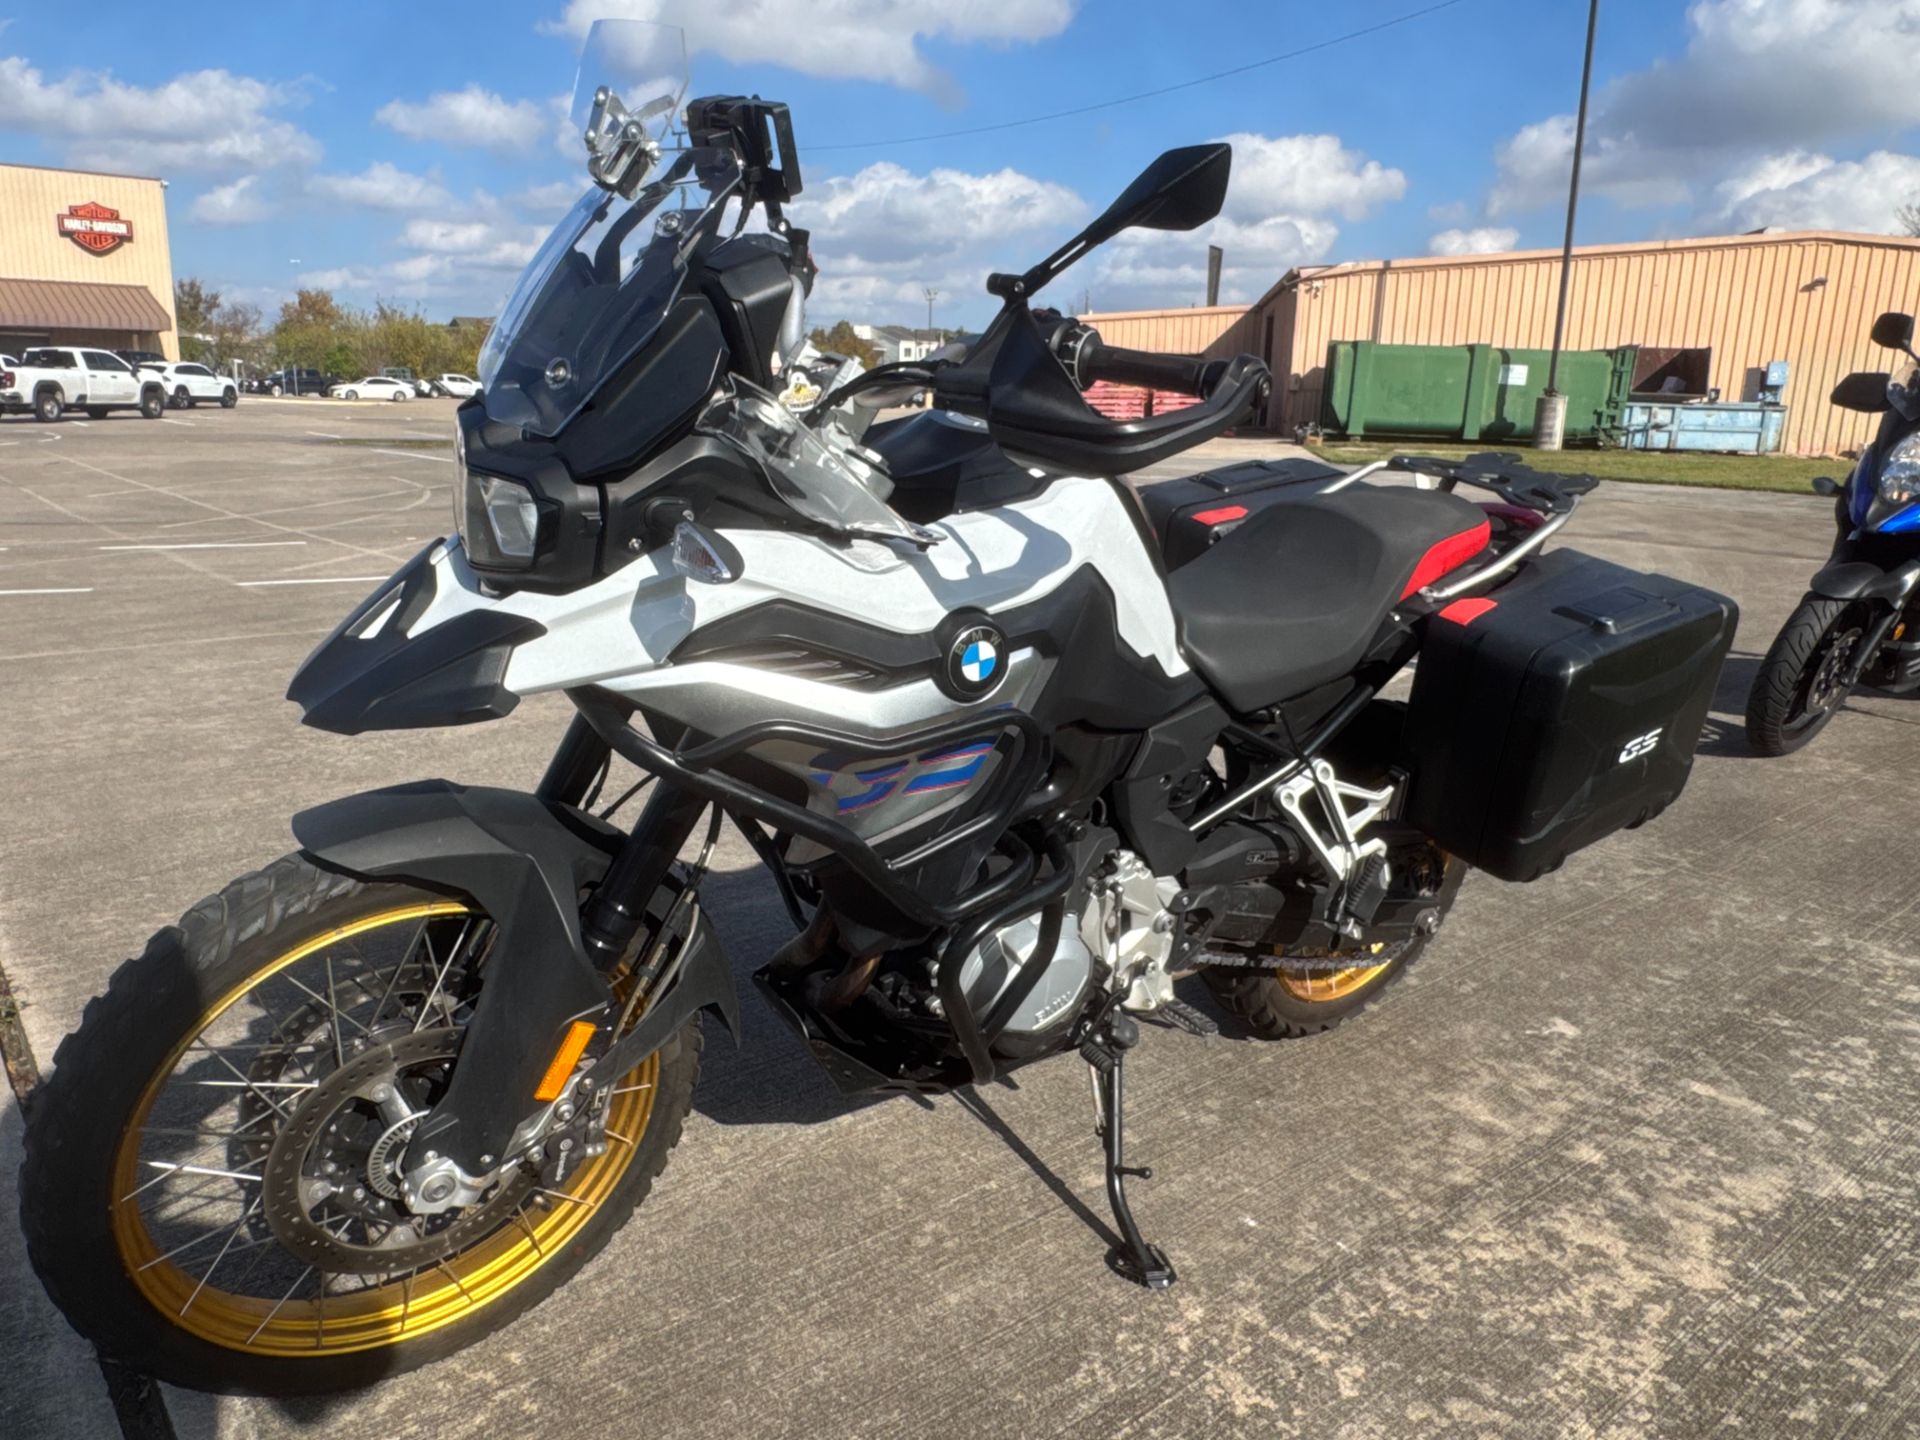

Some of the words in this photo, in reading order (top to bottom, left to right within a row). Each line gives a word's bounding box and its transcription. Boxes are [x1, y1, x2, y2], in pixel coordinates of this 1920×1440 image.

[63, 218, 128, 234] HARLEY-DAVIDSON
[954, 629, 1001, 655] BMW
[1619, 727, 1663, 763] GS
[1034, 990, 1073, 1023] BMW
